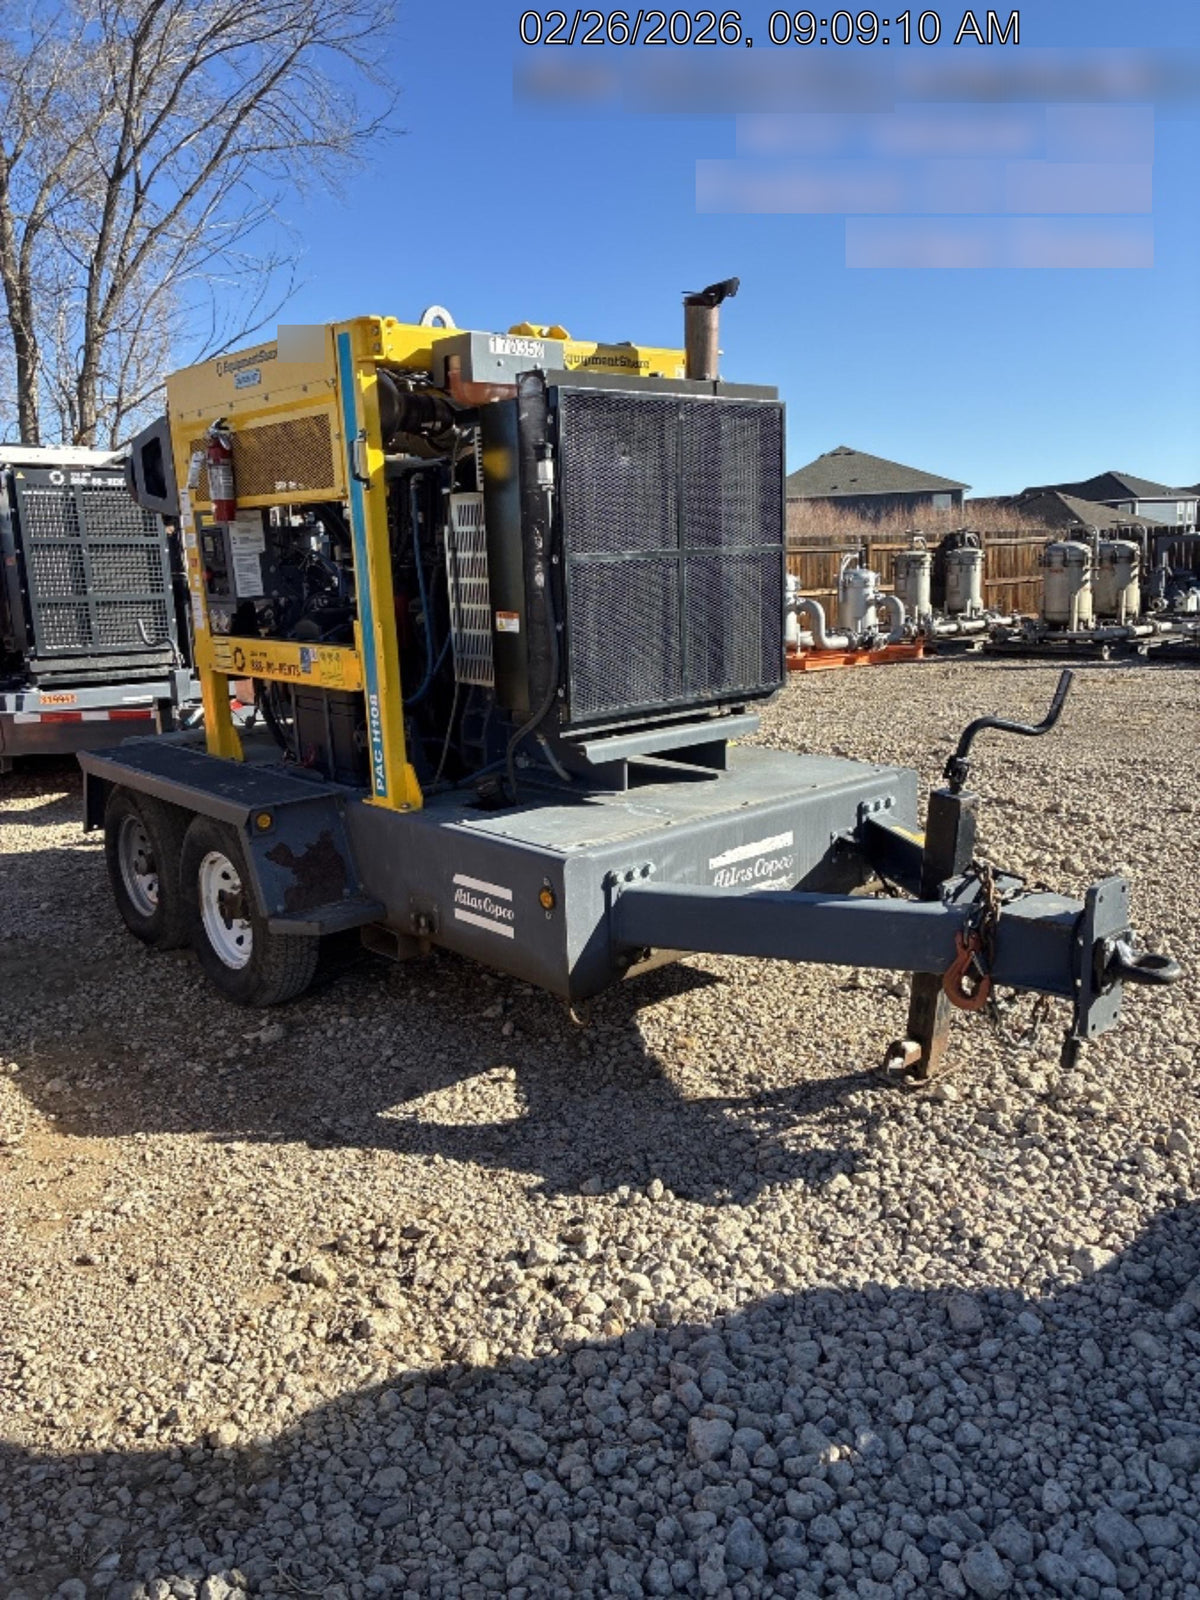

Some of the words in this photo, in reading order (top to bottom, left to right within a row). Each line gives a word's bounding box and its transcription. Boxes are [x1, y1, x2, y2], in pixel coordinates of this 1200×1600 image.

[374, 749, 385, 791] PAC
[713, 867, 753, 888] Atlas
[753, 854, 794, 878] Copco
[454, 888, 482, 911] Atlas
[483, 897, 514, 921] Copco
